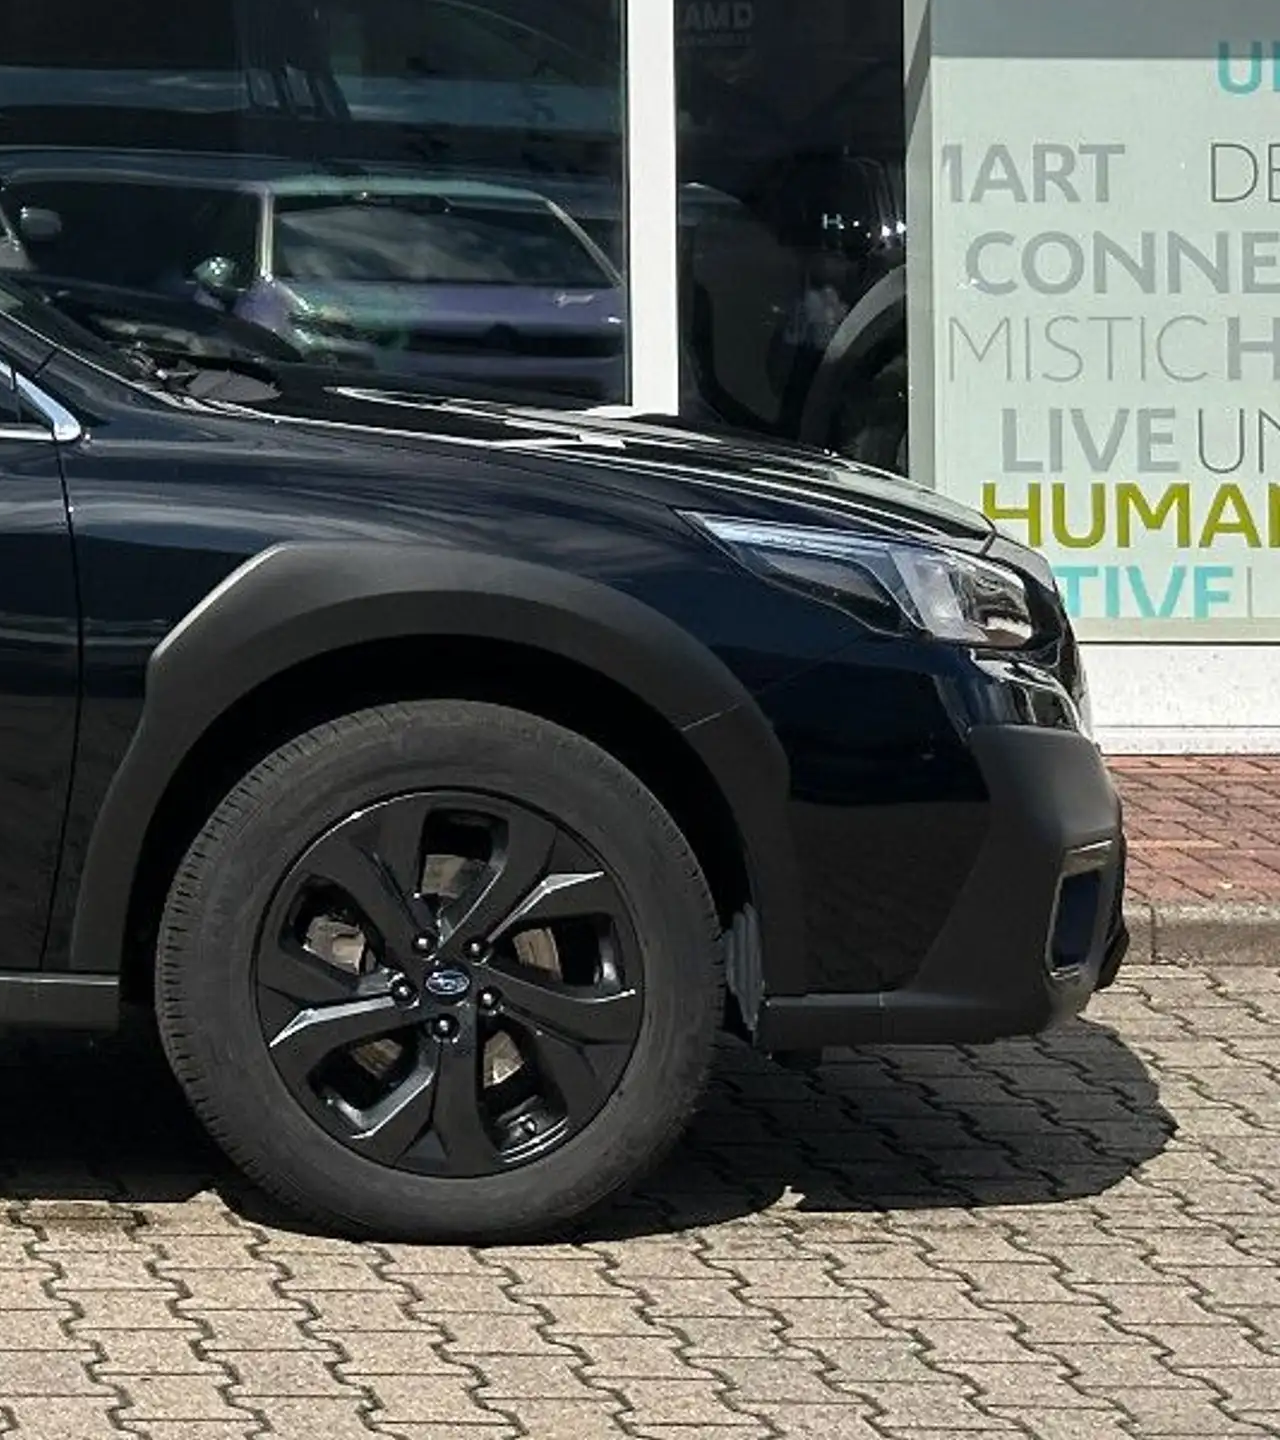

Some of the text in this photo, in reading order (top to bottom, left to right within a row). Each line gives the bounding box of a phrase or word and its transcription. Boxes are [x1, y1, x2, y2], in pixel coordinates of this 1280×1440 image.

[965, 230, 1280, 295] CONNE
[948, 314, 1209, 383] MISTIC
[1002, 408, 1180, 473] LIVE
[982, 482, 1280, 548] HUMA
